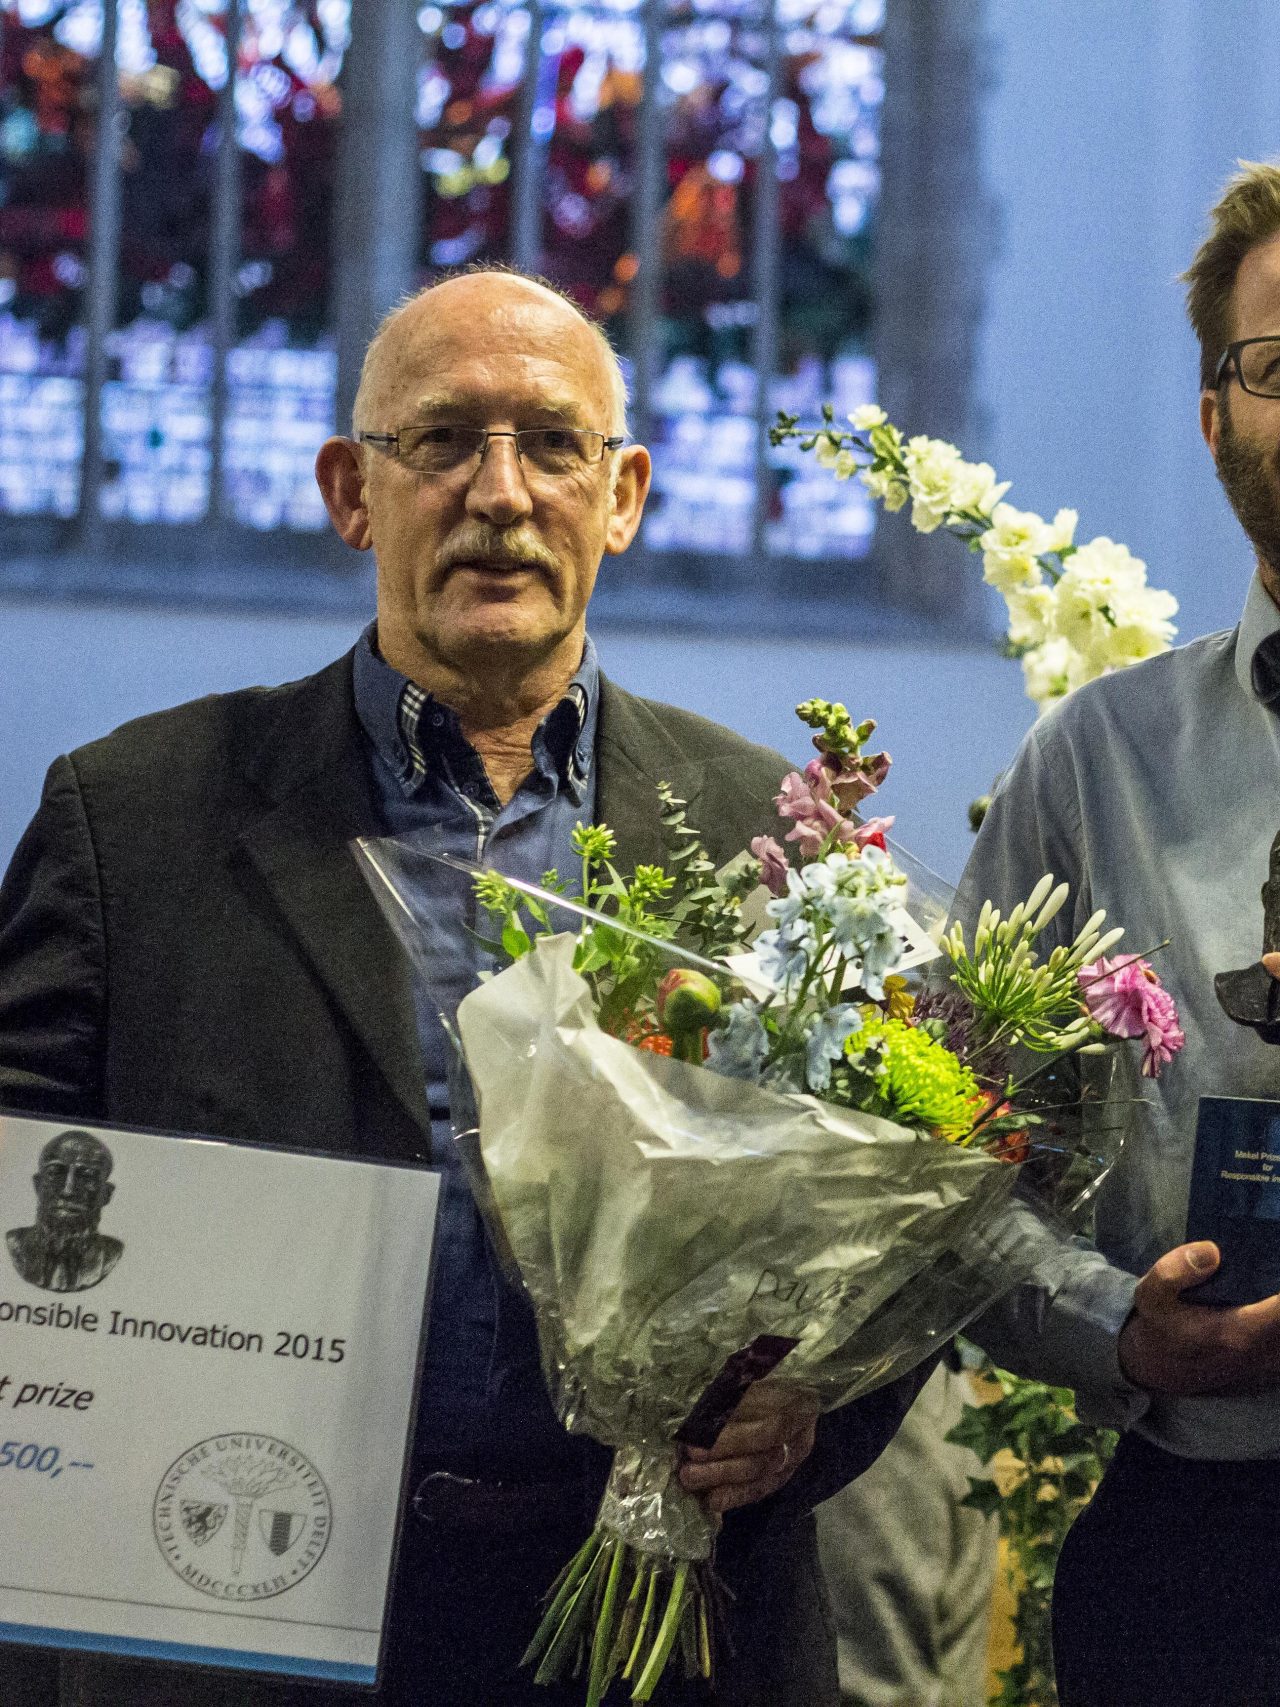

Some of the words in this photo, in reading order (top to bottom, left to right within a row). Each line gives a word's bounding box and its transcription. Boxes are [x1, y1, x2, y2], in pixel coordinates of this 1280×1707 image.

[1262, 1163, 1274, 1172] for
[0, 1302, 99, 1332] onsible
[108, 1310, 264, 1353] Innovation
[273, 1331, 347, 1364] 2015
[12, 1382, 95, 1411] prize
